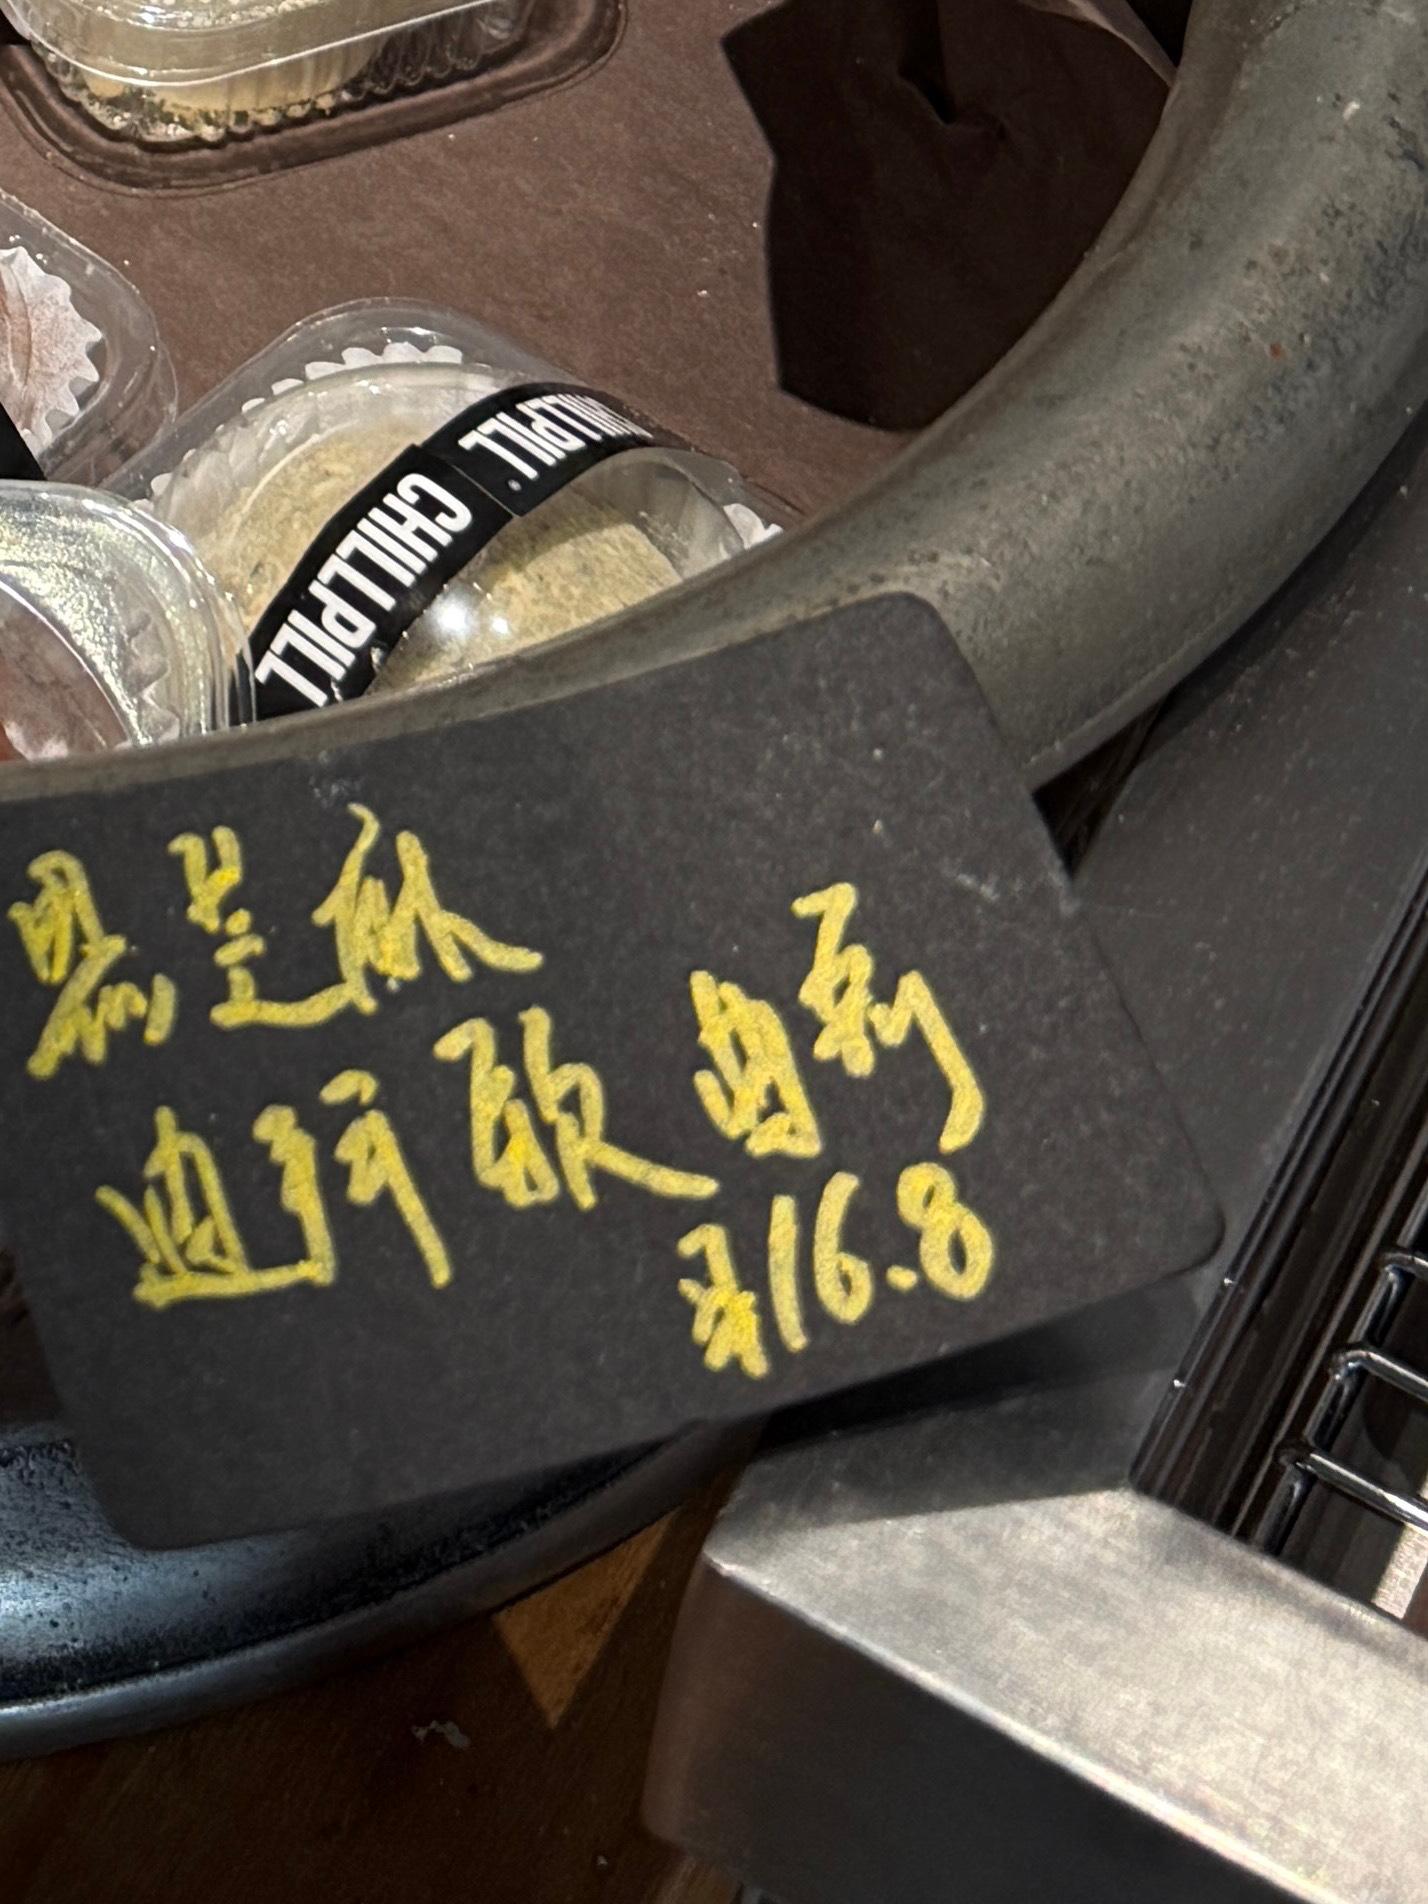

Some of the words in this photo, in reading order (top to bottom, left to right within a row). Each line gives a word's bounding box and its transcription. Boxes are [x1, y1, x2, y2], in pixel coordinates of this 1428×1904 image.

[255, 473, 472, 707] CHILLPILL
[9, 802, 542, 1079] 黑芝麻
